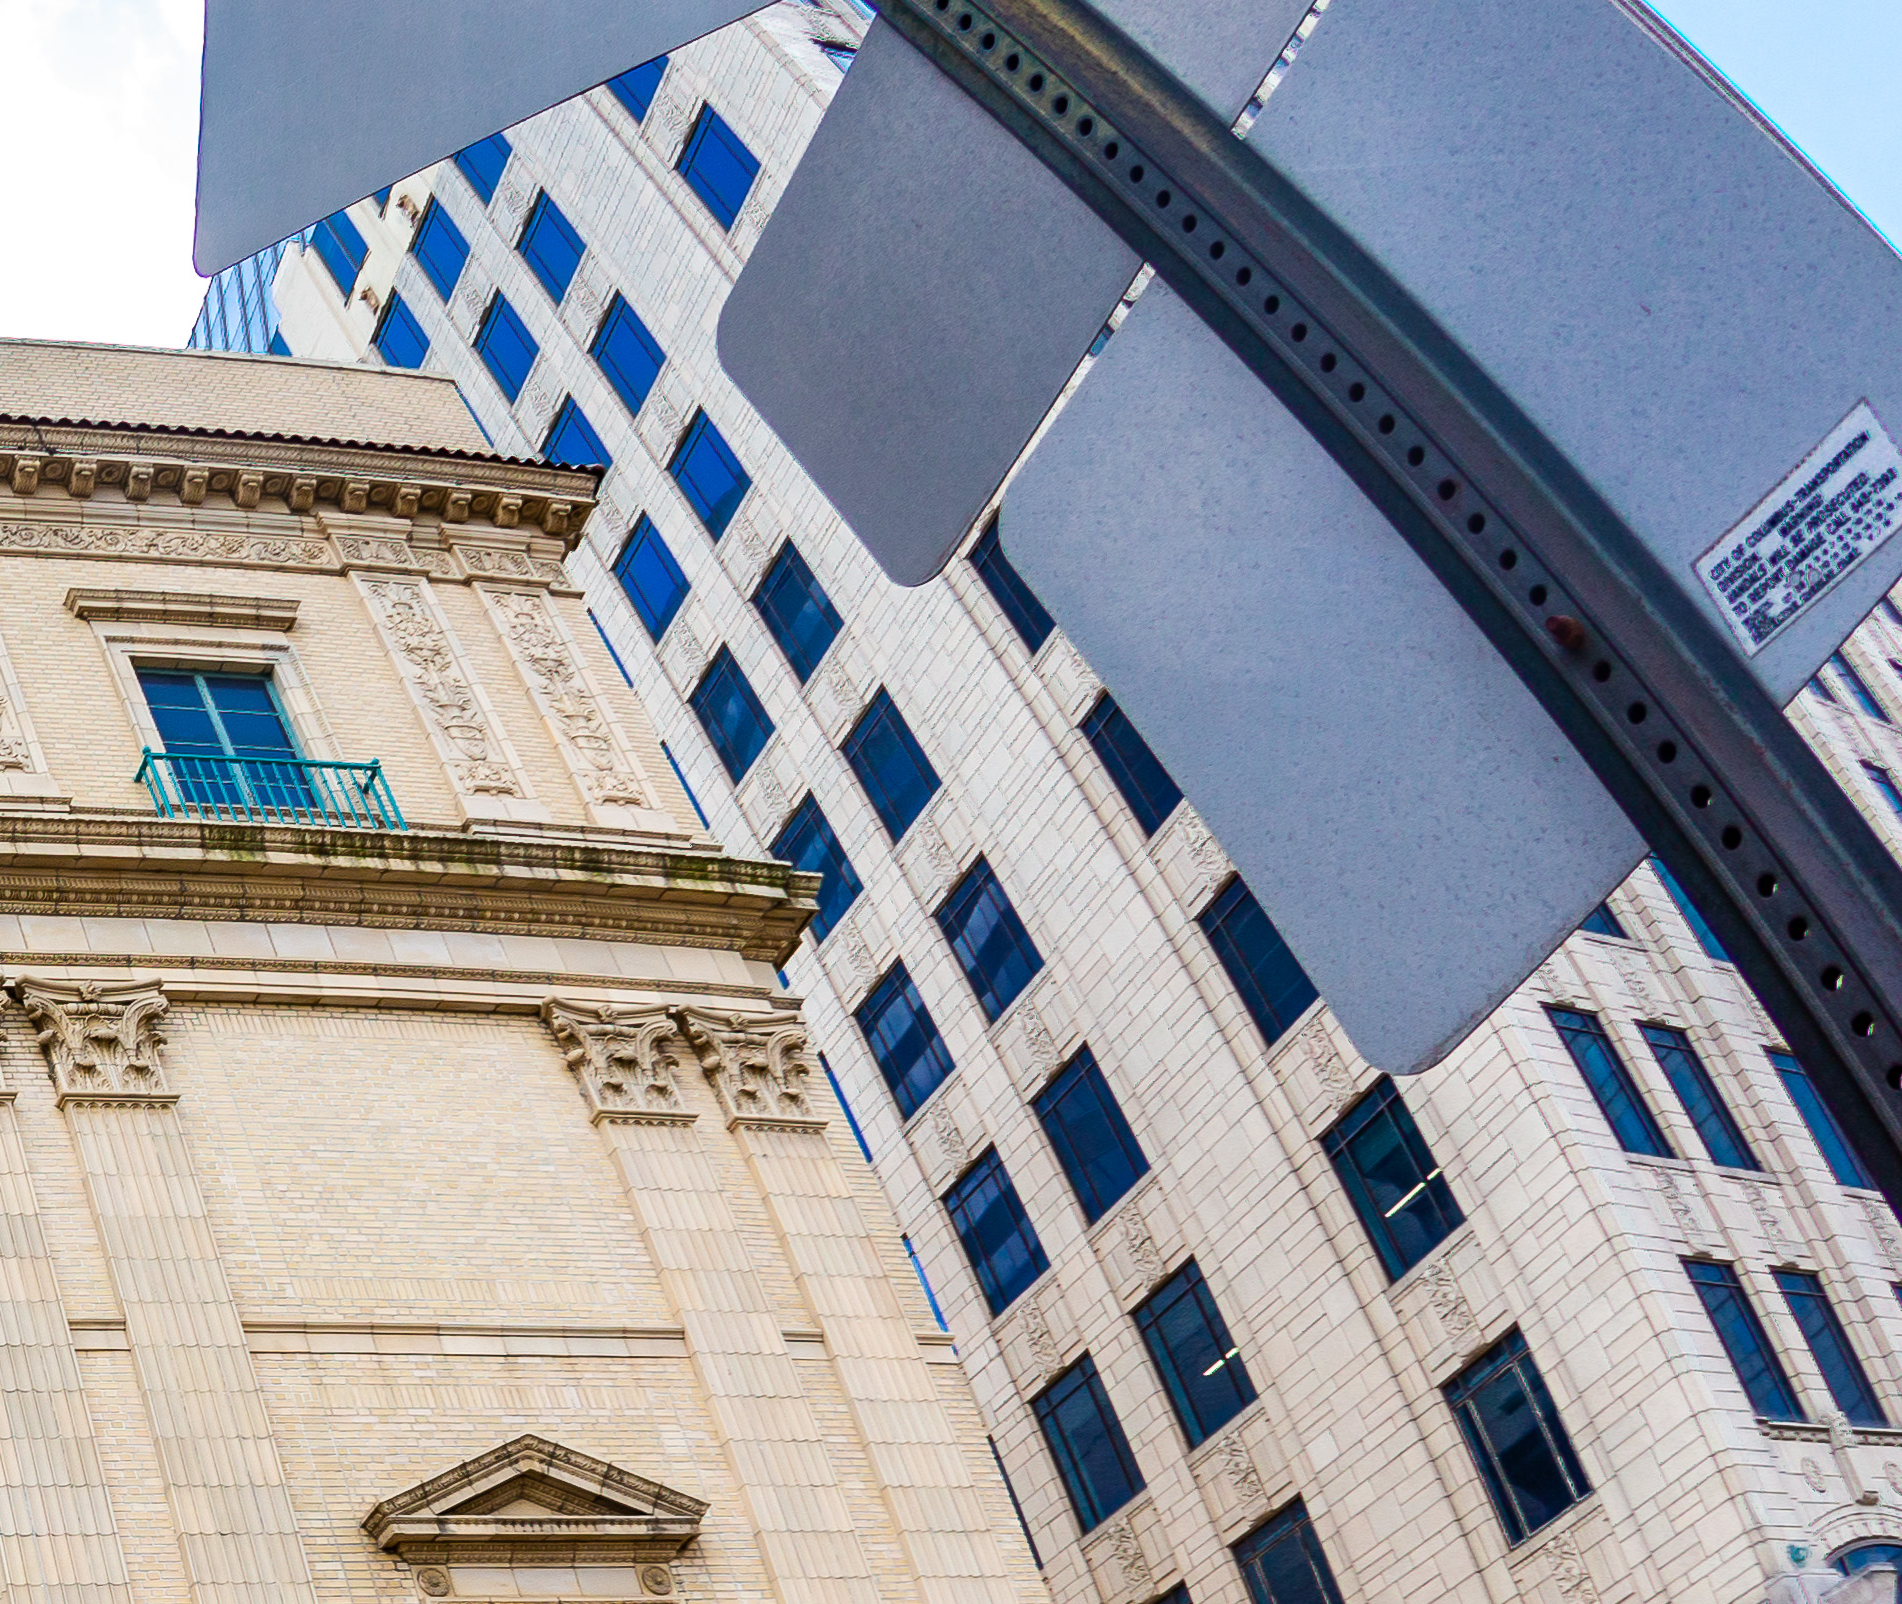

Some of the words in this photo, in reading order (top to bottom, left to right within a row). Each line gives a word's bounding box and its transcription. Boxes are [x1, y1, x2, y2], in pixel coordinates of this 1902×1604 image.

[1709, 557, 1731, 580] CITY
[1730, 544, 1746, 560] OF
[1725, 564, 1767, 602] VANDALS
[1767, 545, 1788, 566] WILL
[1790, 530, 1805, 546] BE
[1733, 601, 1747, 616] TO
[1748, 567, 1786, 603] REPORT
[1787, 533, 1824, 568] DAMAGE
[1825, 510, 1849, 534] CALL
